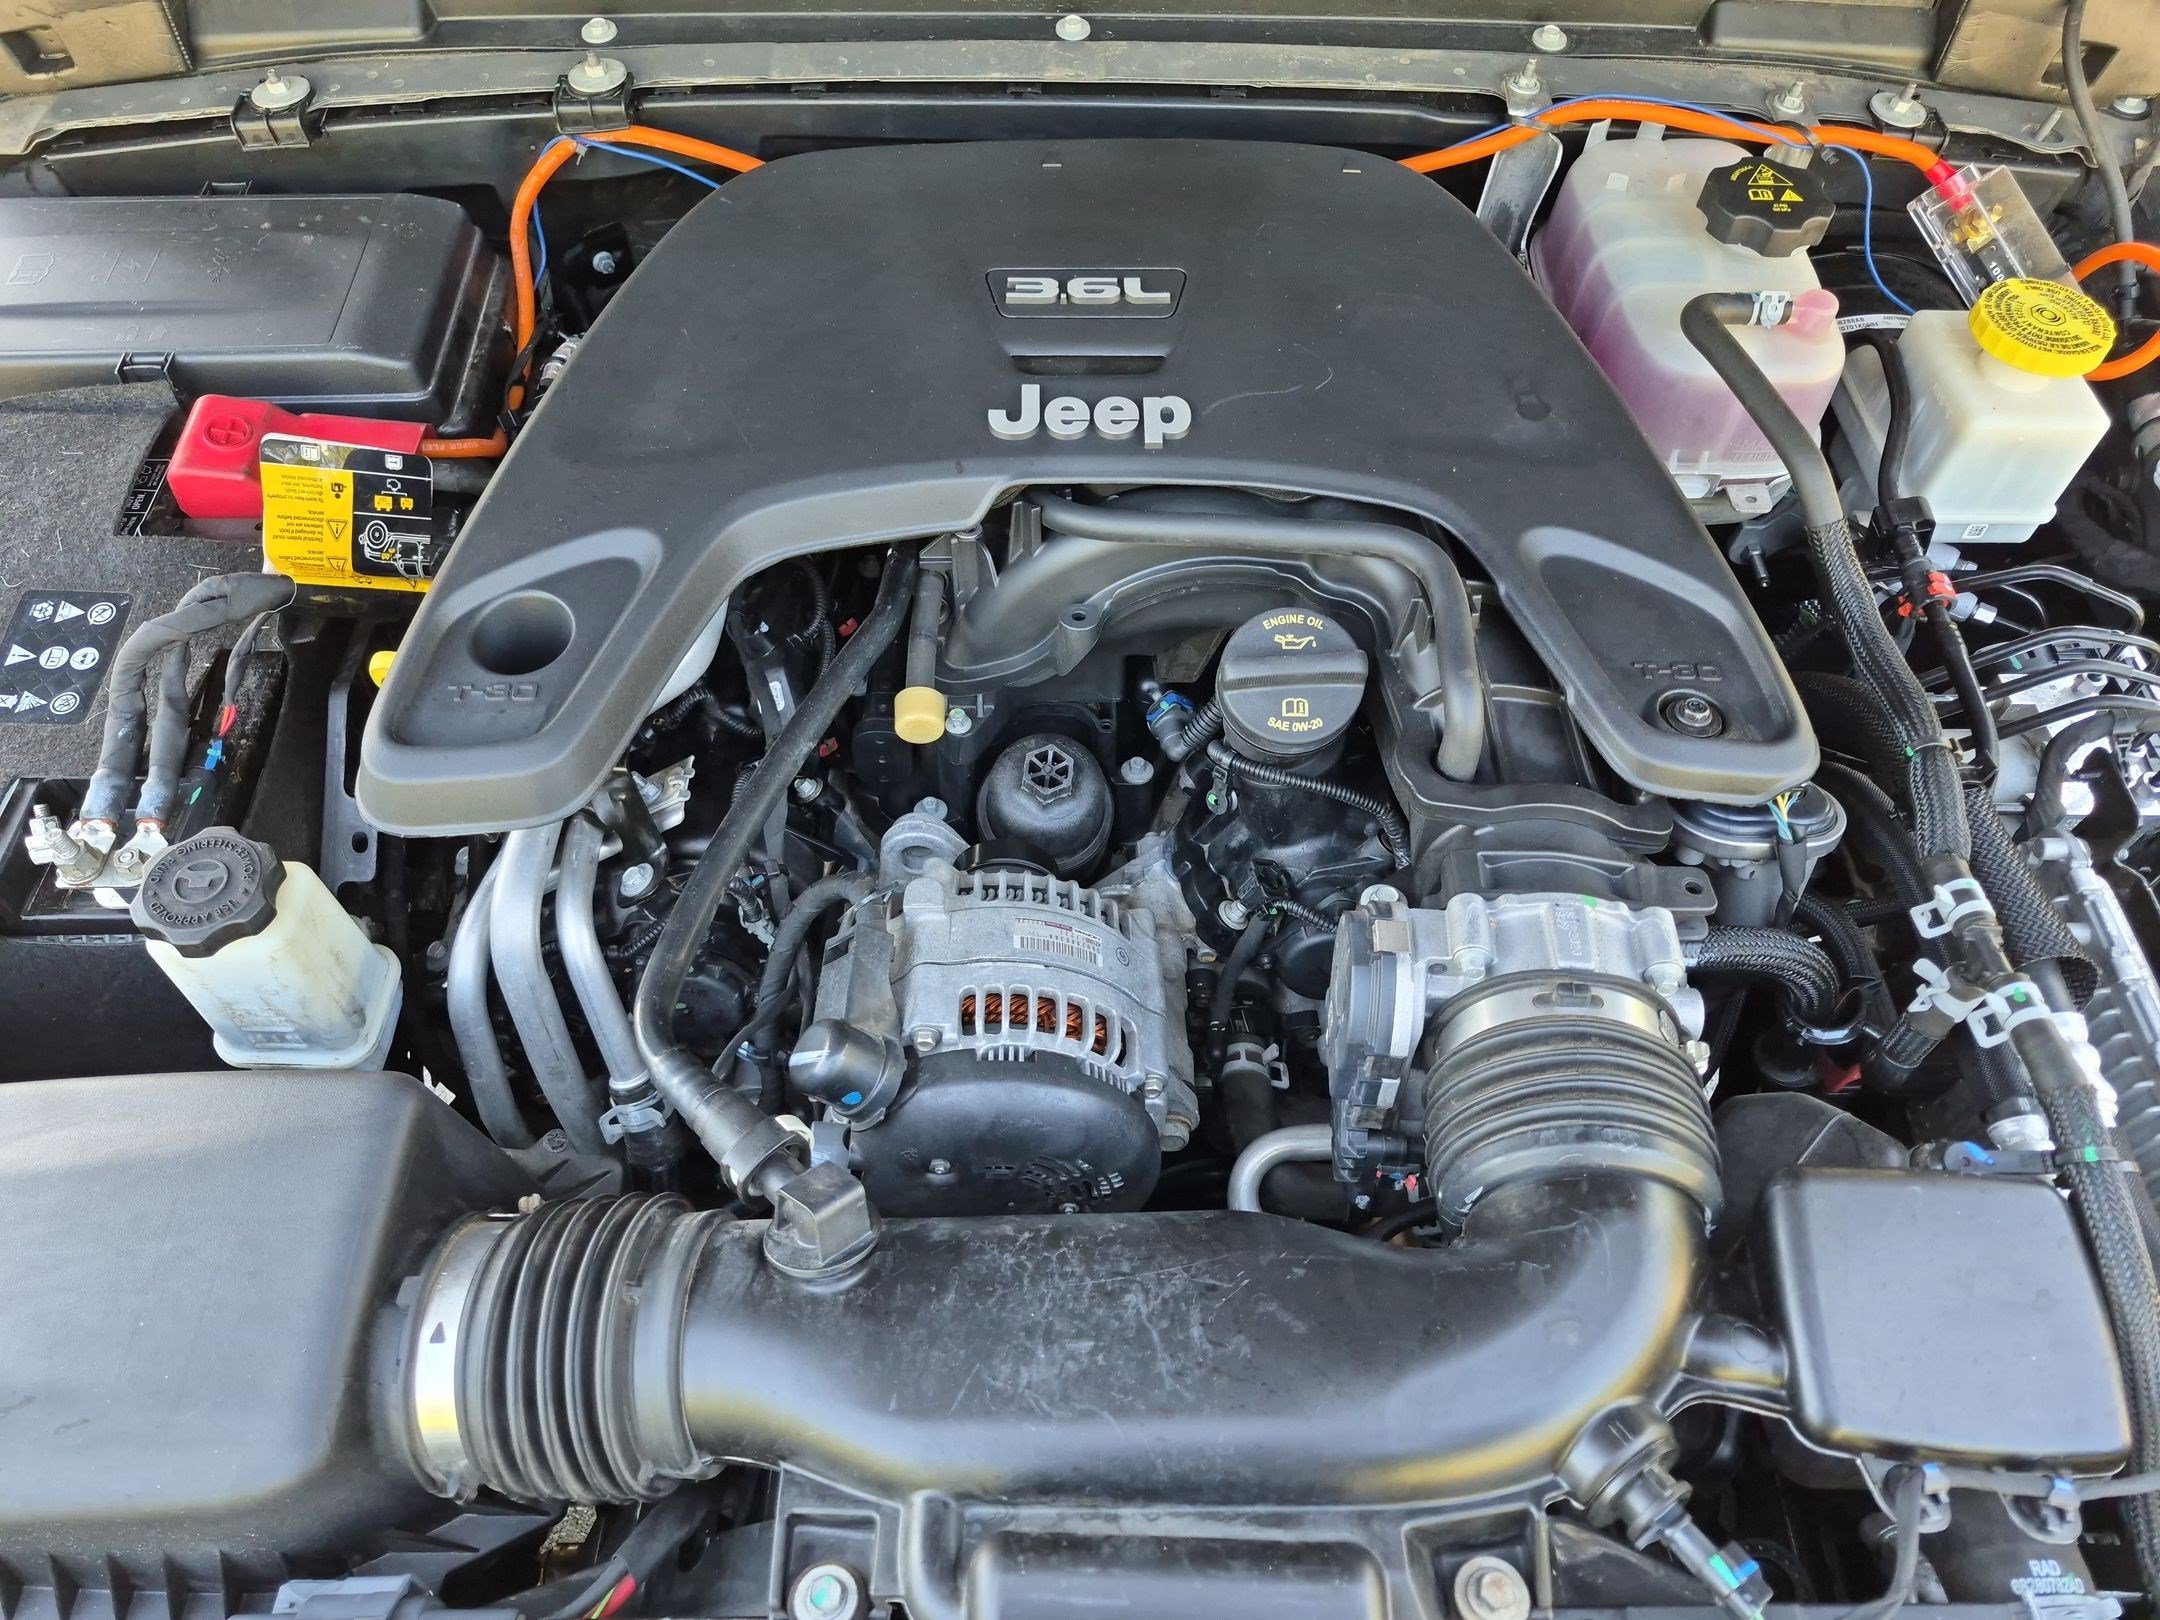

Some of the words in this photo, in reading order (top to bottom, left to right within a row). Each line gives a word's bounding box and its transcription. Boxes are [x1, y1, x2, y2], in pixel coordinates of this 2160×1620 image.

[1989, 261, 2005, 282] 100
[1005, 276, 1171, 306] 3.6L
[988, 384, 1192, 449] Jeep
[449, 442, 479, 450] SUPER
[1262, 613, 1304, 630] ENGINE
[1306, 616, 1325, 630] OIL
[447, 681, 540, 702] T-30
[1267, 716, 1289, 732] SAE
[1292, 717, 1323, 733] 0W-20
[176, 838, 236, 857] STEERING
[149, 855, 177, 885] FLUID
[235, 846, 257, 882] POWER
[149, 900, 210, 926] APPROVED
[214, 898, 240, 918] USE
[2028, 1559, 2062, 1577] RAD
